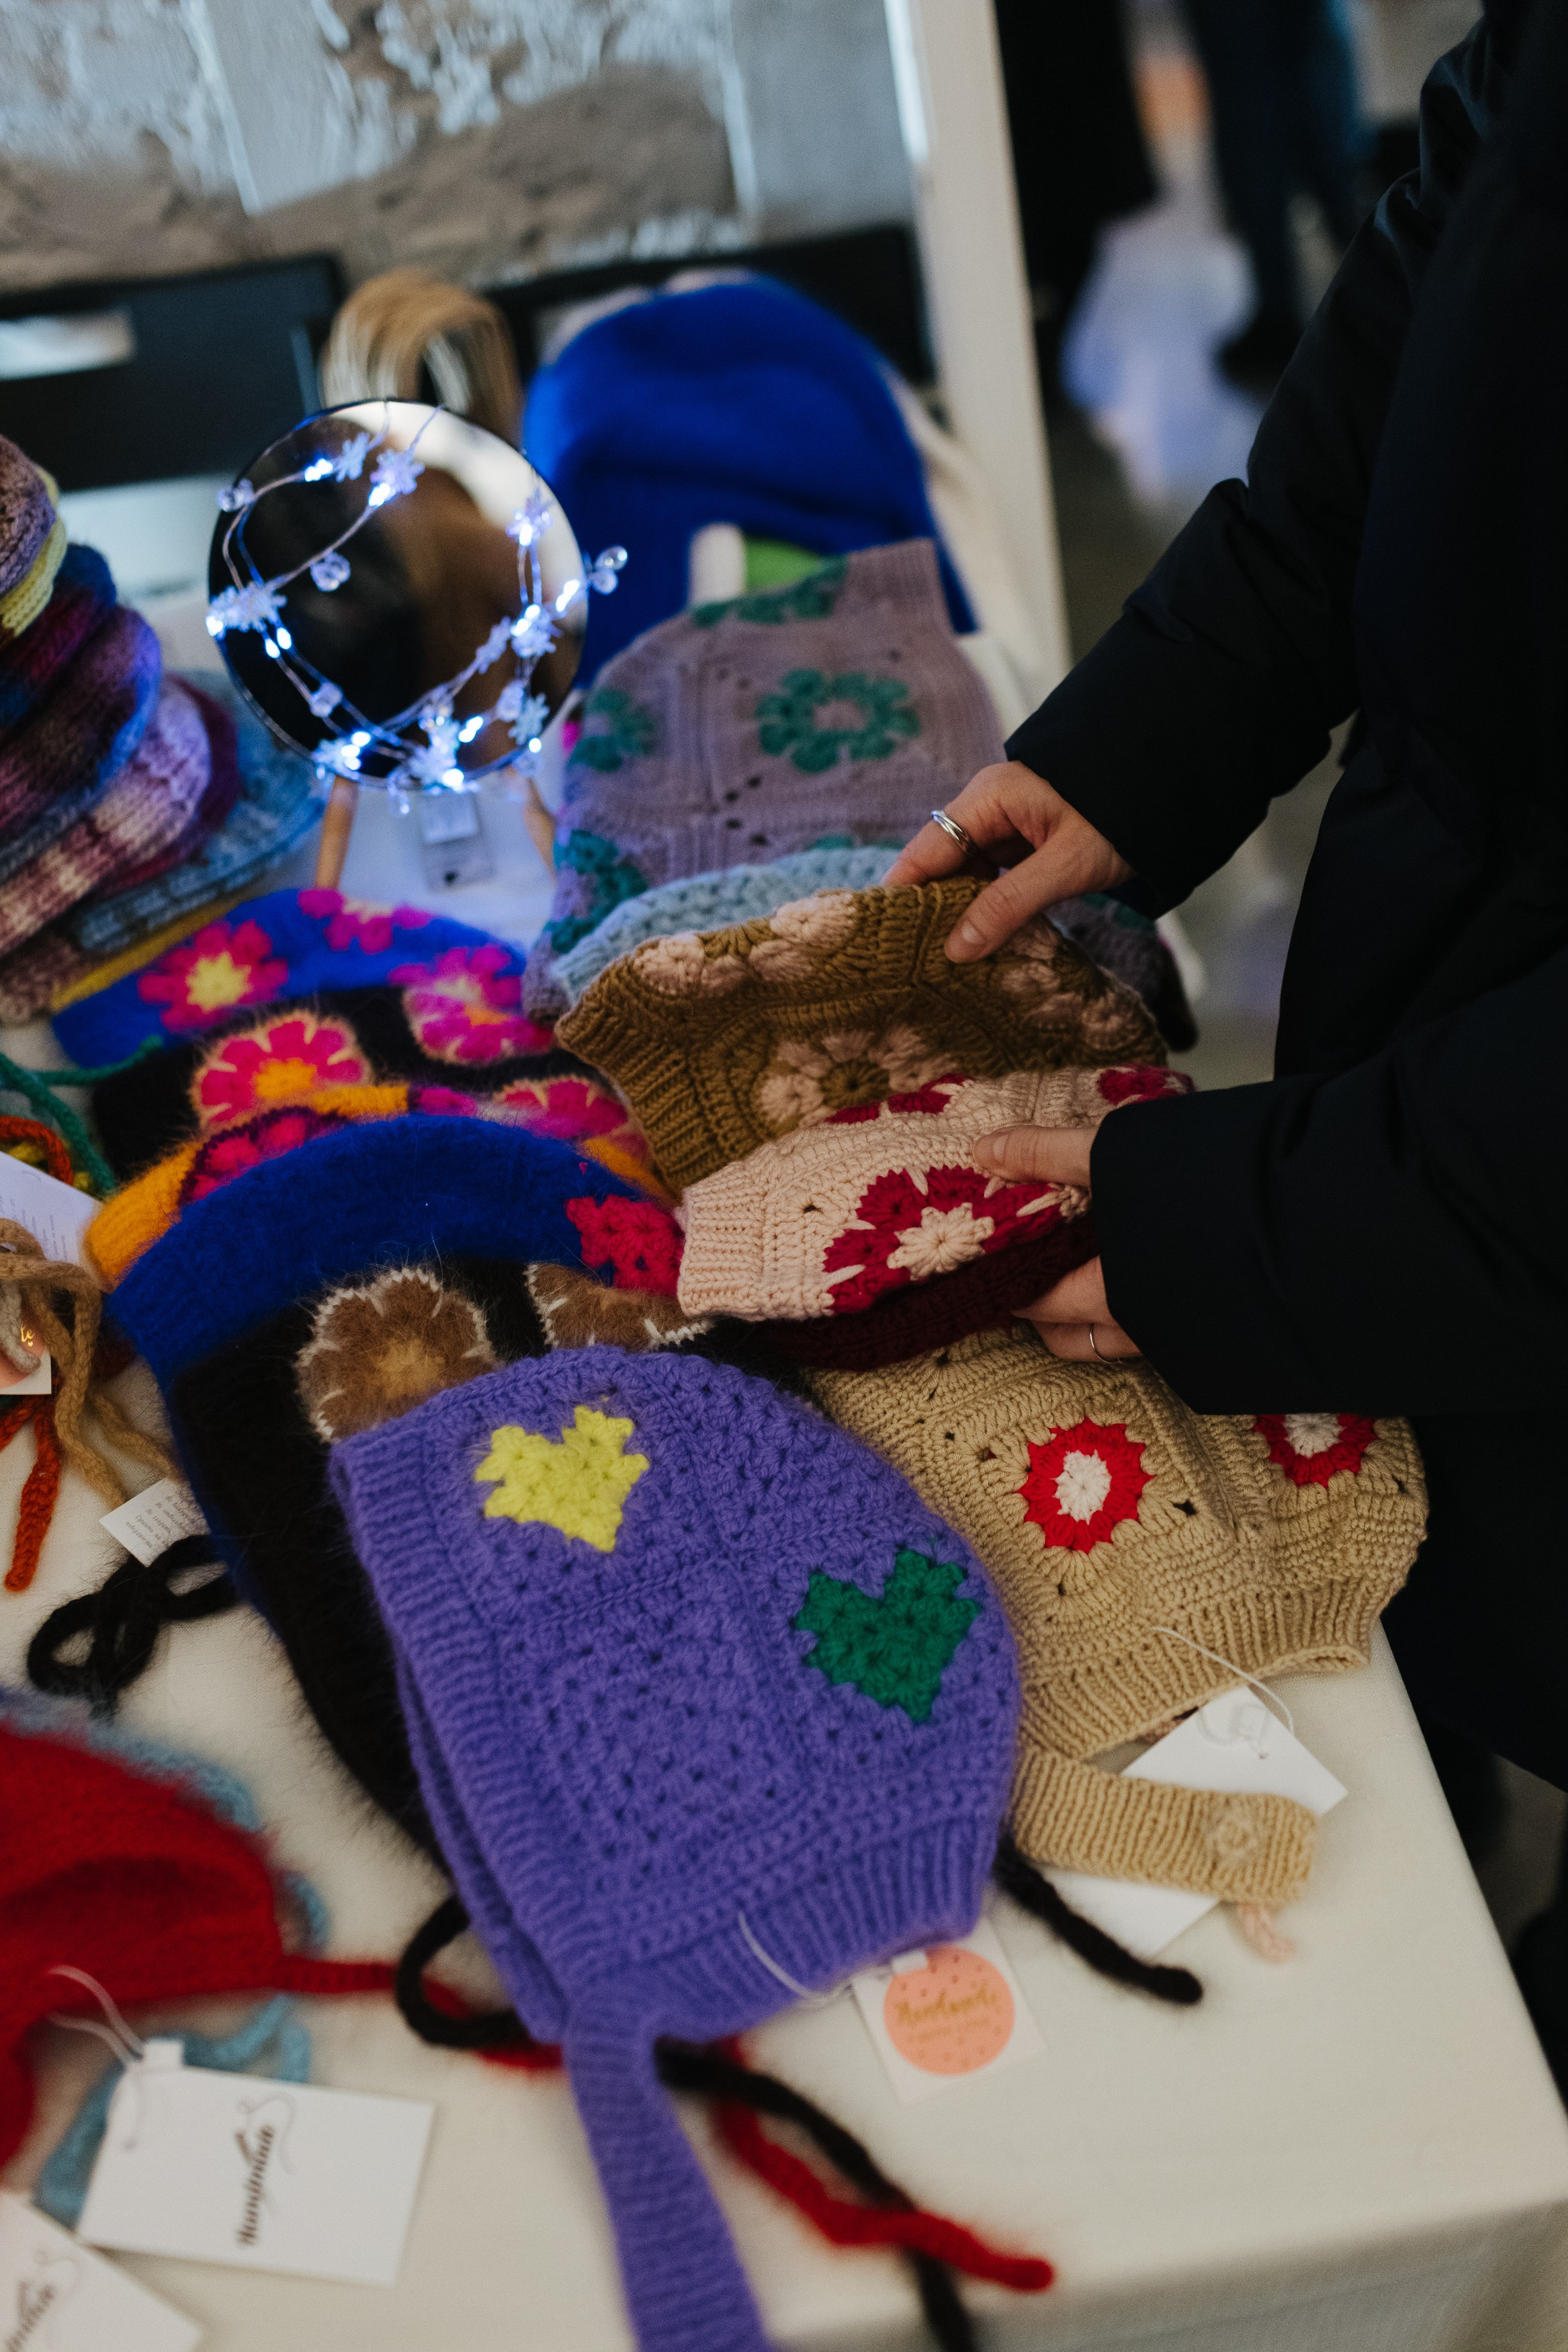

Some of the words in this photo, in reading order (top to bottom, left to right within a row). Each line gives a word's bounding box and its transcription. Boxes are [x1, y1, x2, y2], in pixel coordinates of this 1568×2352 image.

[135, 1515, 155, 1532] Сушить
[152, 1516, 172, 1534] гладить
[163, 1509, 189, 1534] отбеливать
[173, 1502, 202, 1529] выкручив
[125, 1521, 153, 1547] поверхности
